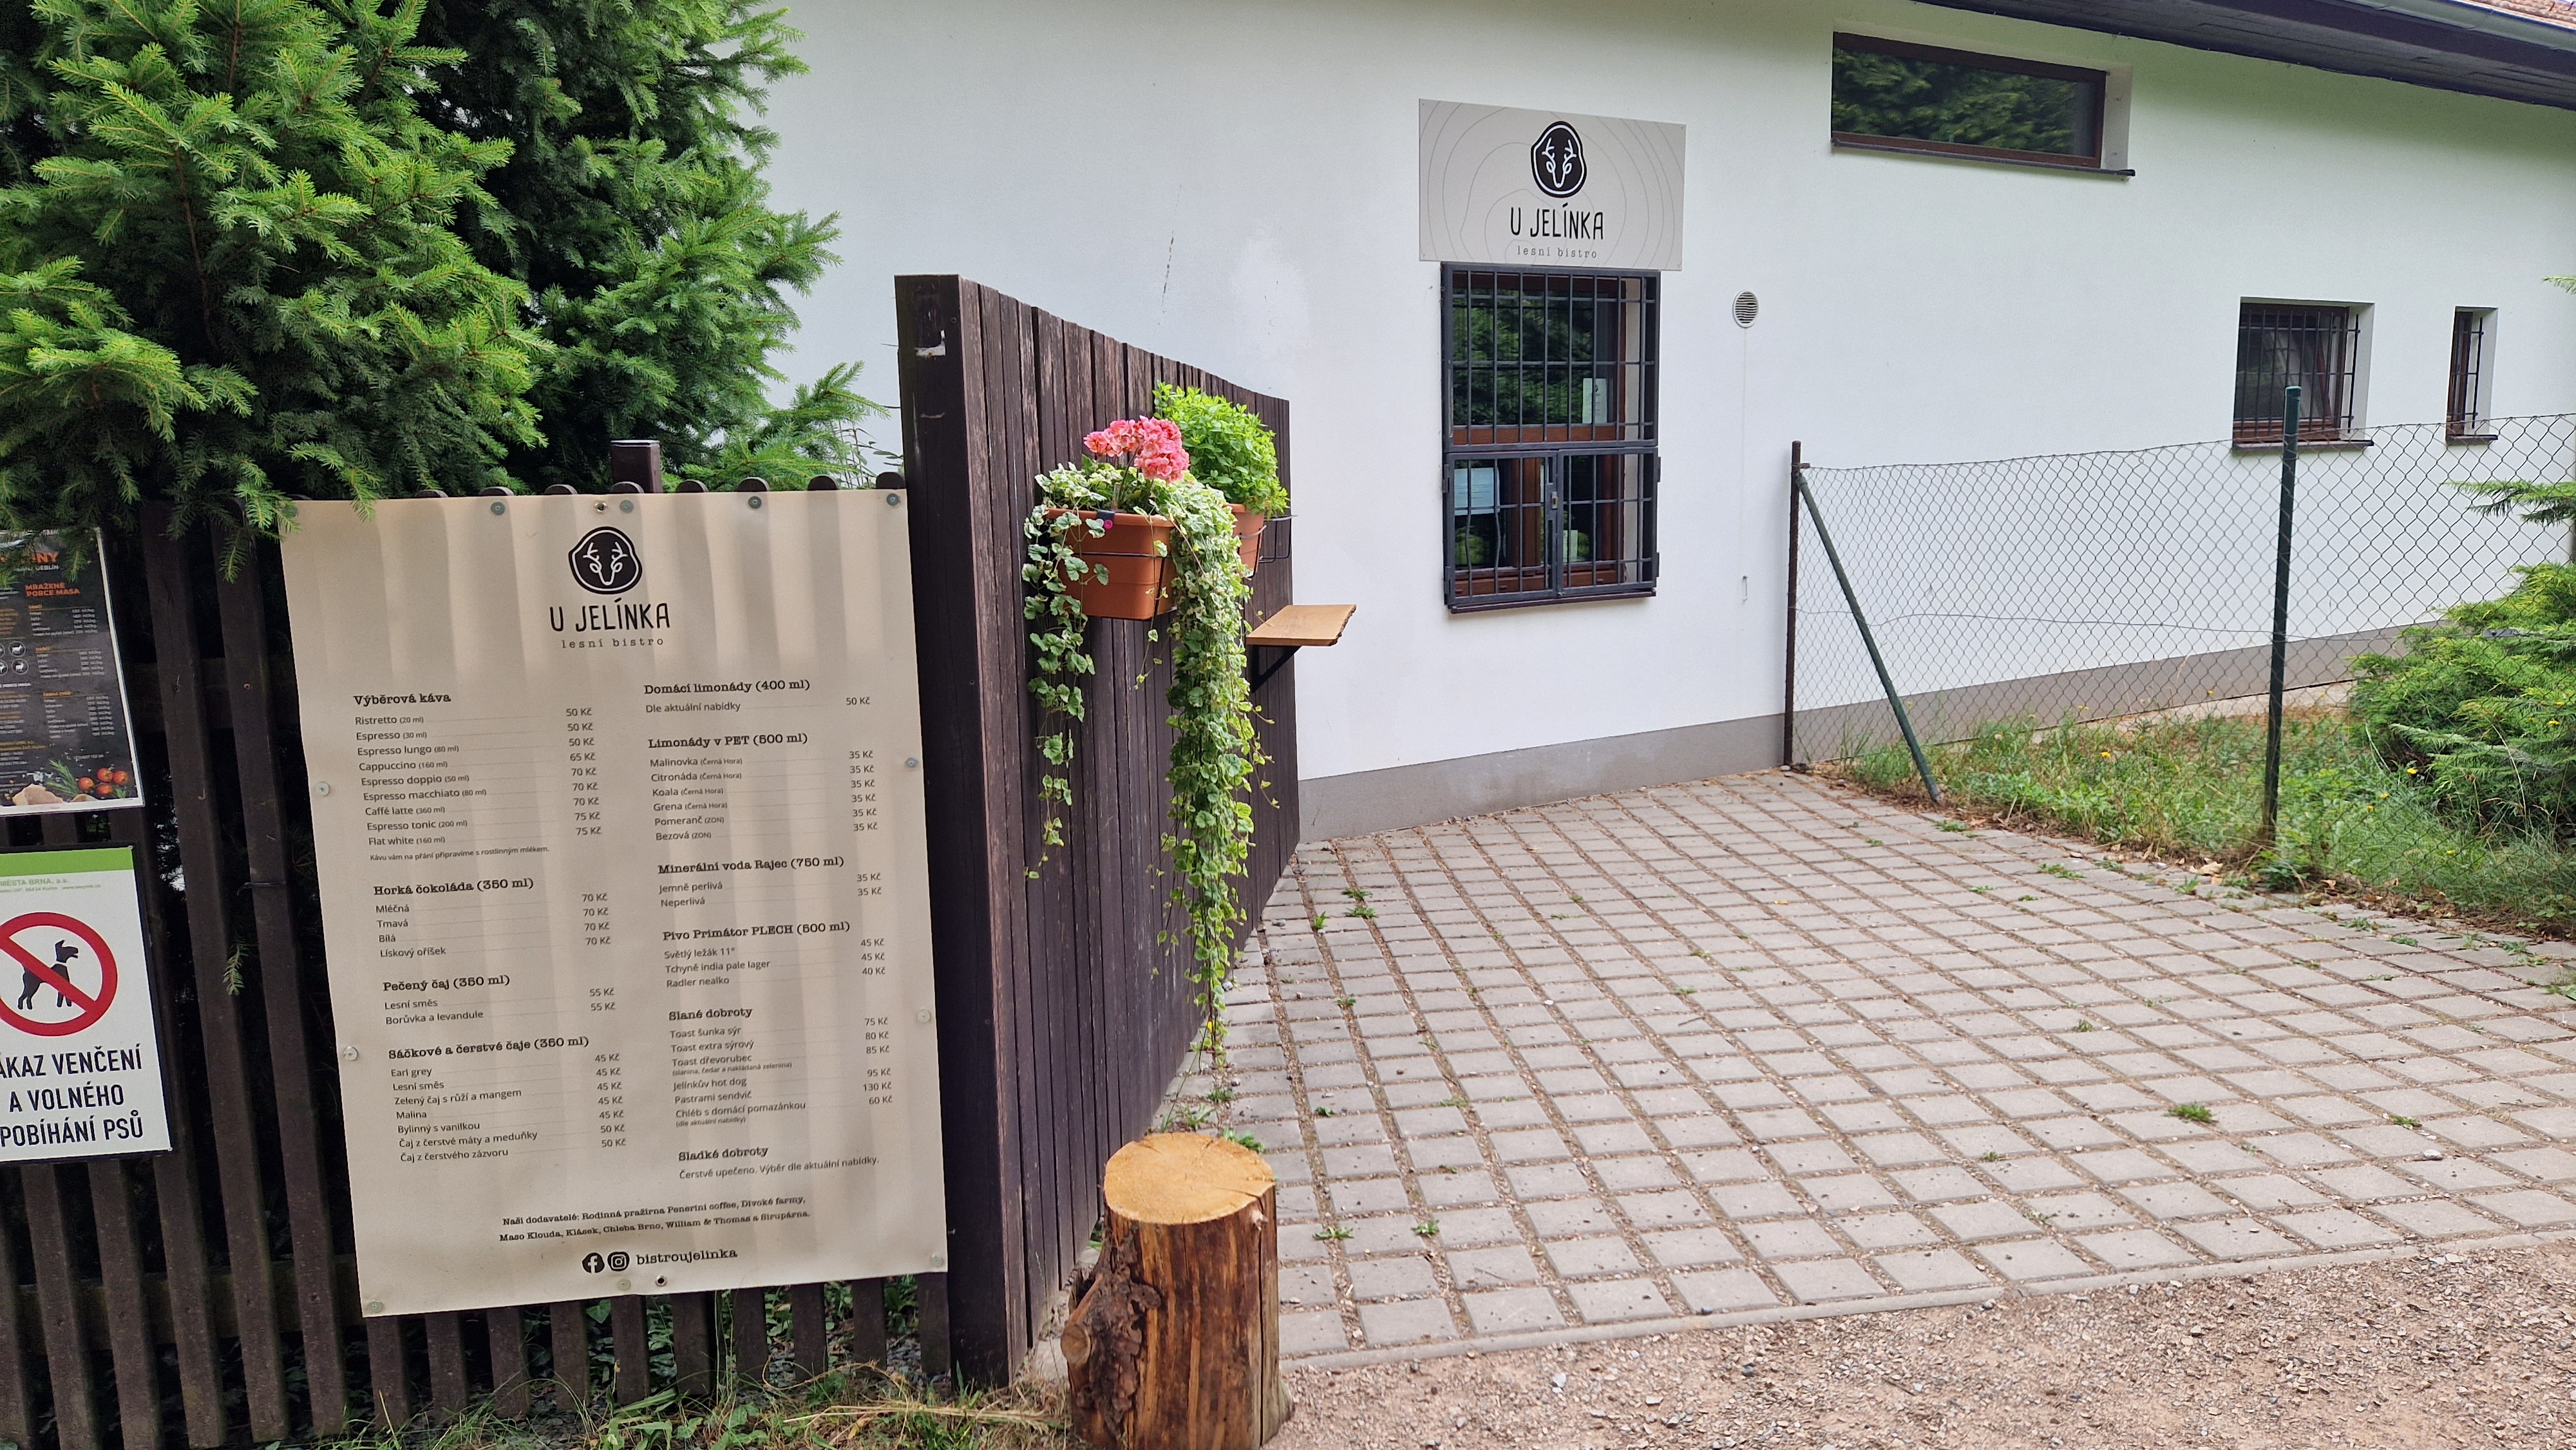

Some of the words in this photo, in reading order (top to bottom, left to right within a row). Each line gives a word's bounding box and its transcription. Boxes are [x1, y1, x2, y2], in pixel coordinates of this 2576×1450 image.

[1510, 207, 1521, 236] U
[1530, 202, 1604, 240] JELÍNKA
[1517, 245, 1550, 256] lesní
[1557, 247, 1597, 258] bistro
[24, 582, 66, 590] MRAŽENÉ
[549, 605, 564, 632] U
[574, 597, 670, 632] JELÍNKA
[561, 638, 603, 649] lesní
[611, 637, 664, 647] bistro
[643, 683, 692, 695] Domácí
[693, 681, 753, 693] limonády
[755, 679, 786, 693] (400
[788, 679, 810, 692] ml)
[352, 693, 417, 708] Výběrová
[418, 692, 452, 703] káva
[645, 704, 662, 713] Dle
[664, 702, 702, 712] aktuální
[703, 701, 741, 713] nabídky
[565, 708, 578, 717] 50
[580, 707, 592, 717] Kč
[355, 716, 398, 726] Ristretto
[399, 717, 412, 725] (20
[355, 731, 401, 743] Espresso
[402, 731, 415, 740] (30
[648, 737, 712, 749] Limonády
[713, 738, 723, 746] v
[724, 735, 750, 746] PET
[752, 733, 784, 747] (500
[786, 732, 808, 745] ml)
[650, 757, 698, 767] Malinovka
[700, 757, 723, 766] (Černá
[657, 862, 720, 874] Minerální
[721, 860, 753, 871] voda
[753, 860, 788, 871] Rajec
[790, 857, 820, 870] (750
[822, 856, 844, 868] ml)
[372, 885, 414, 896] Horká
[415, 881, 475, 894] čokoláda
[476, 878, 509, 892] (350
[511, 877, 534, 890] ml)
[658, 883, 690, 895] Jemně
[691, 881, 723, 893] perlivá
[375, 903, 410, 914] Mléčná
[660, 896, 706, 909] Neperlivá
[375, 918, 409, 928] Tmavá
[662, 931, 690, 941] Pivo
[692, 927, 749, 939] Primátor
[750, 924, 794, 936] PLECH
[797, 923, 826, 936] (500
[829, 921, 850, 933] ml)
[378, 934, 396, 943] Bílá
[380, 947, 415, 959] Lískový
[416, 946, 446, 956] oříšek
[664, 948, 692, 961] Světlý
[694, 948, 719, 958] ležák
[720, 946, 736, 957] 11°
[665, 963, 699, 975] Tchyně
[701, 962, 724, 972] india
[726, 961, 746, 972] pale
[747, 960, 771, 970] lager
[382, 980, 429, 992] Pečený
[431, 979, 450, 990] čaj
[453, 976, 485, 990] (350
[487, 974, 511, 986] ml)
[666, 978, 697, 988] Radler
[699, 976, 730, 986] nealko
[589, 988, 601, 997] 55
[603, 987, 615, 997] Kč
[384, 999, 411, 1010] Lesní
[412, 999, 439, 1008] směs
[385, 1014, 426, 1025] Borůvka
[437, 1010, 484, 1021] levandule
[668, 1009, 703, 1021] Slané
[705, 1007, 753, 1019] dobroty
[669, 1030, 696, 1039] Toast
[697, 1027, 725, 1037] šunka
[727, 1026, 742, 1037] sýr
[388, 1046, 442, 1060] Sáčkové
[444, 1046, 454, 1055] a
[455, 1041, 503, 1054] čerstvé
[506, 1040, 531, 1052] čaje
[533, 1037, 565, 1051] (350
[567, 1035, 589, 1048] ml)
[670, 1044, 697, 1053] Toast
[698, 1042, 723, 1051] extra
[724, 1039, 754, 1051] sýrový
[52, 1043, 142, 1075] VENČENÍ
[671, 1058, 697, 1068] Toast
[699, 1054, 752, 1065] dřevorubec
[390, 1068, 409, 1077] Earl
[411, 1068, 433, 1078] grey
[867, 1069, 878, 1077] 95
[880, 1068, 891, 1077] Kč
[392, 1082, 417, 1091] Lesní
[419, 1080, 445, 1091] směs
[672, 1079, 710, 1092] Jelínkův
[711, 1078, 728, 1088] hot
[728, 1077, 747, 1088] dog
[863, 1082, 879, 1092] 130
[881, 1081, 892, 1091] Kč
[9, 1091, 23, 1113] A
[26, 1080, 124, 1111] VOLNÉHO
[393, 1095, 425, 1107] Zelený
[426, 1095, 440, 1106] čaj
[450, 1092, 469, 1102] růží
[479, 1090, 522, 1100] mangem
[674, 1093, 715, 1104] Pastrami
[717, 1090, 752, 1101] sendvič
[396, 1110, 428, 1120] Malina
[675, 1108, 703, 1118] Chléb
[711, 1104, 746, 1116] domácí
[747, 1101, 806, 1116] pomazánkou
[0, 1115, 96, 1147] POBÍHÁNÍ
[103, 1109, 143, 1140] PSŮ
[397, 1124, 431, 1135] Bylinný
[440, 1122, 480, 1132] vanilkou
[399, 1138, 414, 1150] Čaj
[422, 1136, 457, 1147] čerstvé
[458, 1135, 482, 1146] máty
[493, 1131, 538, 1143] meduňky
[400, 1152, 415, 1163] Čaj
[424, 1150, 470, 1161] čerstvého
[471, 1149, 509, 1159] zázvoru
[678, 1149, 719, 1162] Sladké
[721, 1146, 769, 1158] dobroty
[679, 1168, 714, 1180] Čerstvě
[715, 1166, 757, 1179] upečeno.
[759, 1163, 786, 1175] Výběr
[787, 1162, 802, 1171] dle
[804, 1159, 840, 1171] aktuální
[842, 1156, 879, 1167] nabídky.
[635, 1248, 738, 1265] bistroujelinka
